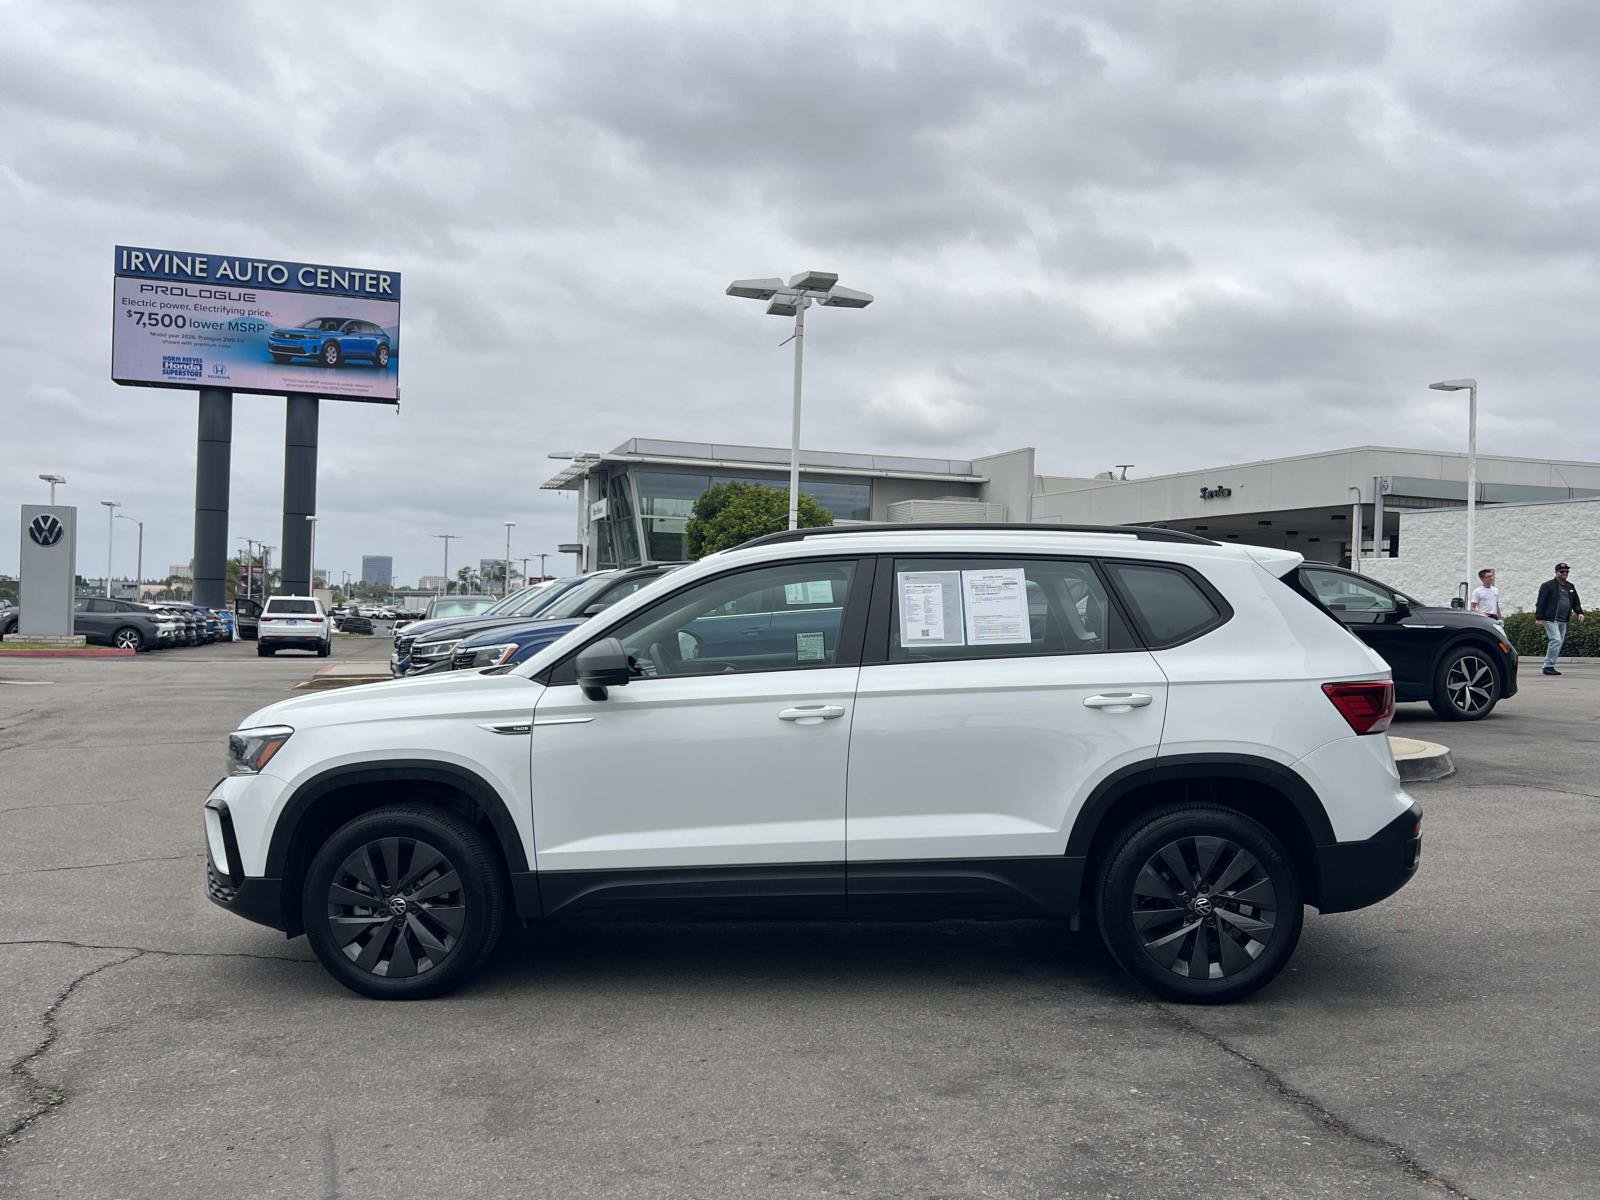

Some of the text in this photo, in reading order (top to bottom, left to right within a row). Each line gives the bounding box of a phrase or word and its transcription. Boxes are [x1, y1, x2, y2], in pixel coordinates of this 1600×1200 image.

[121, 249, 392, 294] IRVINE AUTO CENTER
[139, 284, 257, 303] PROLOGUE
[121, 297, 158, 308] Electric
[193, 303, 246, 317] Electrifying
[126, 309, 187, 329] $7,500
[189, 318, 225, 331] lower
[162, 369, 203, 378] SUPERSTORE
[165, 361, 201, 371] Honda
